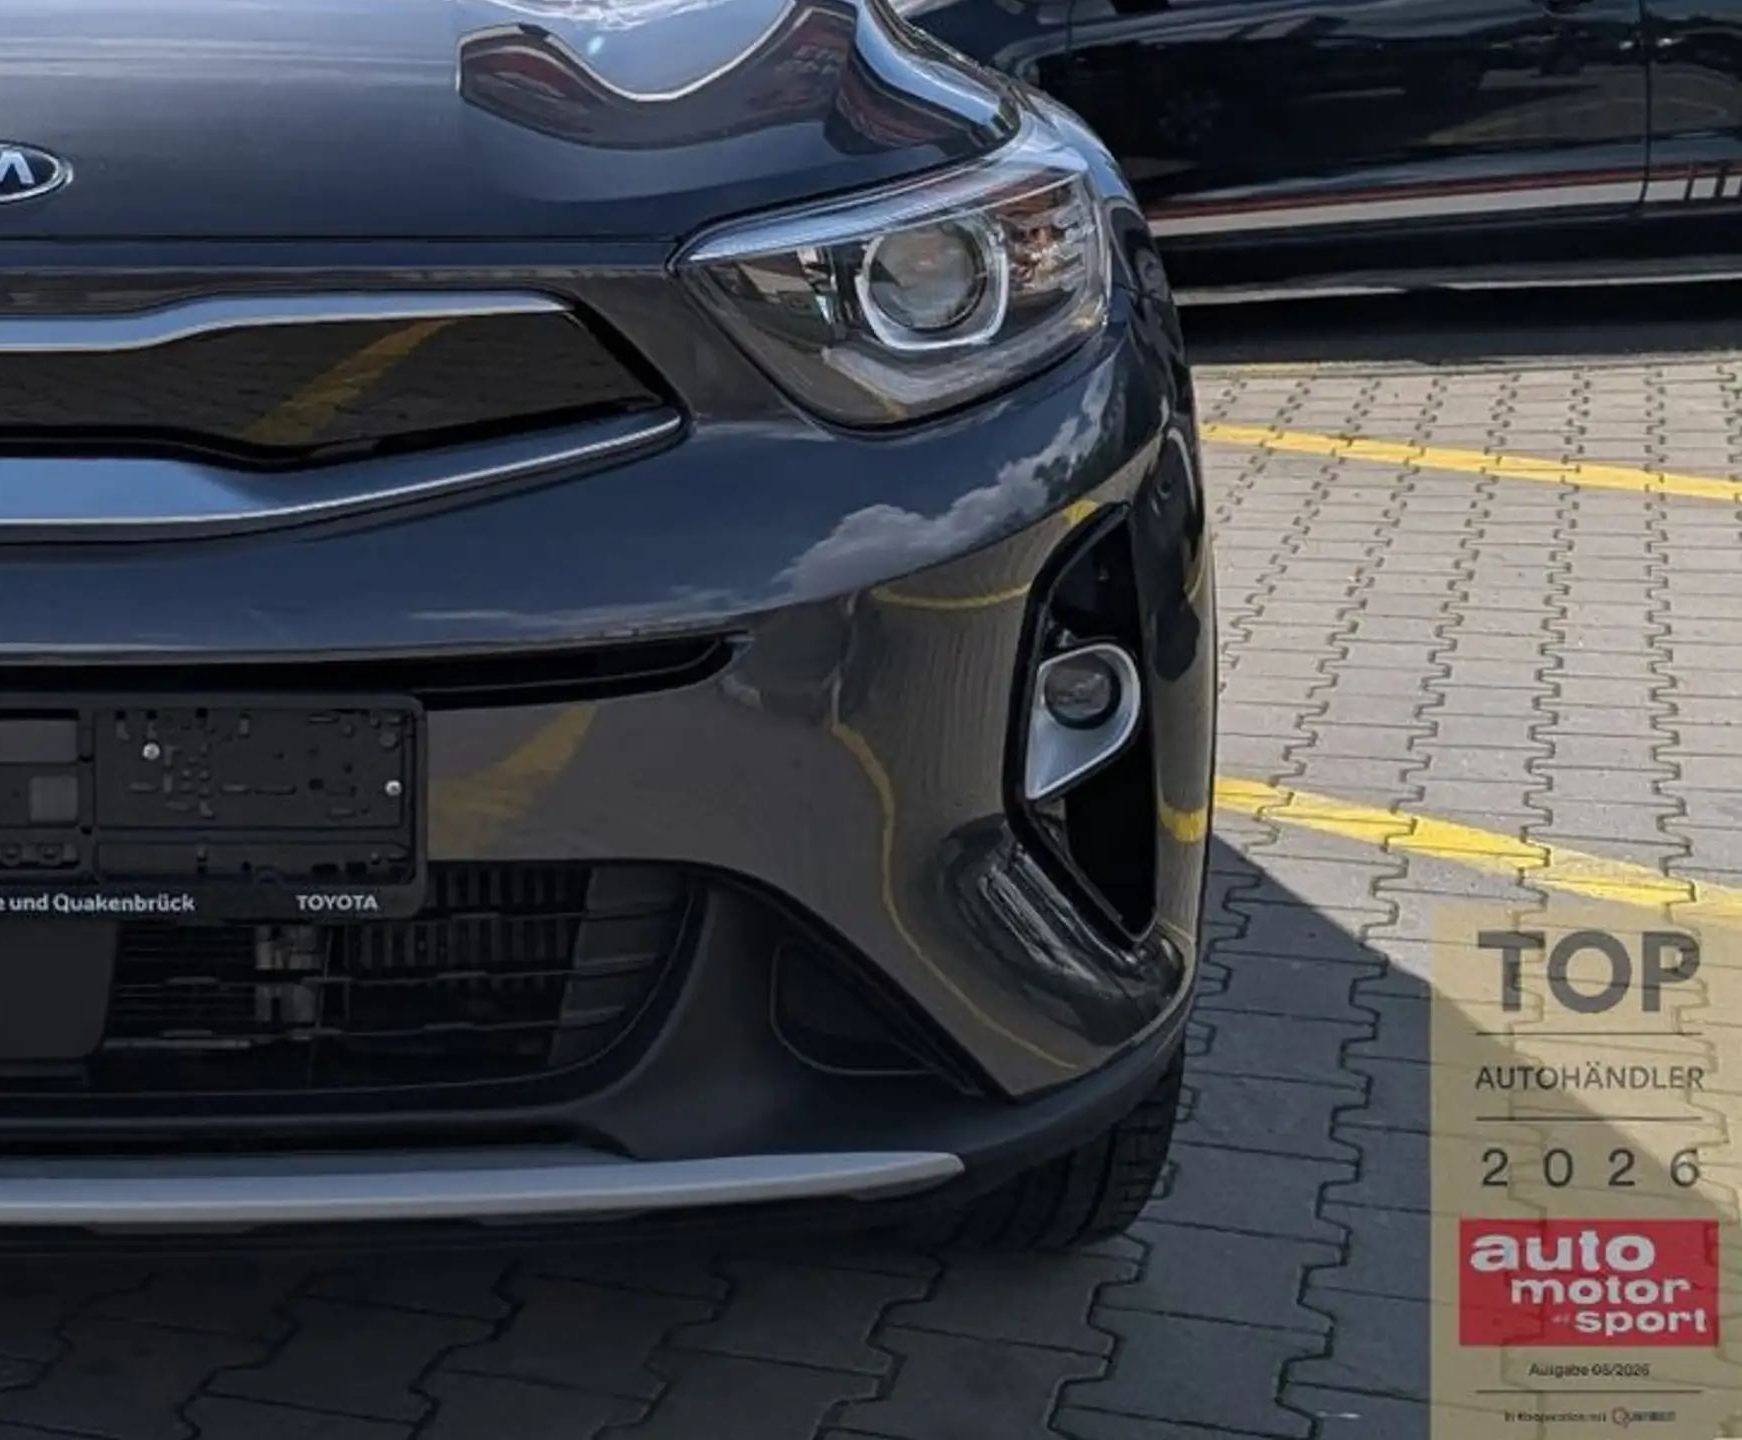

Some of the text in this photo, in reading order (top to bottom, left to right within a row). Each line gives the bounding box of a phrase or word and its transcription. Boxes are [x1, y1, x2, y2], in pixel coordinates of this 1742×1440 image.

[10, 894, 49, 912] und
[52, 892, 196, 914] Quakenbrück
[295, 893, 379, 912] TOYOTA
